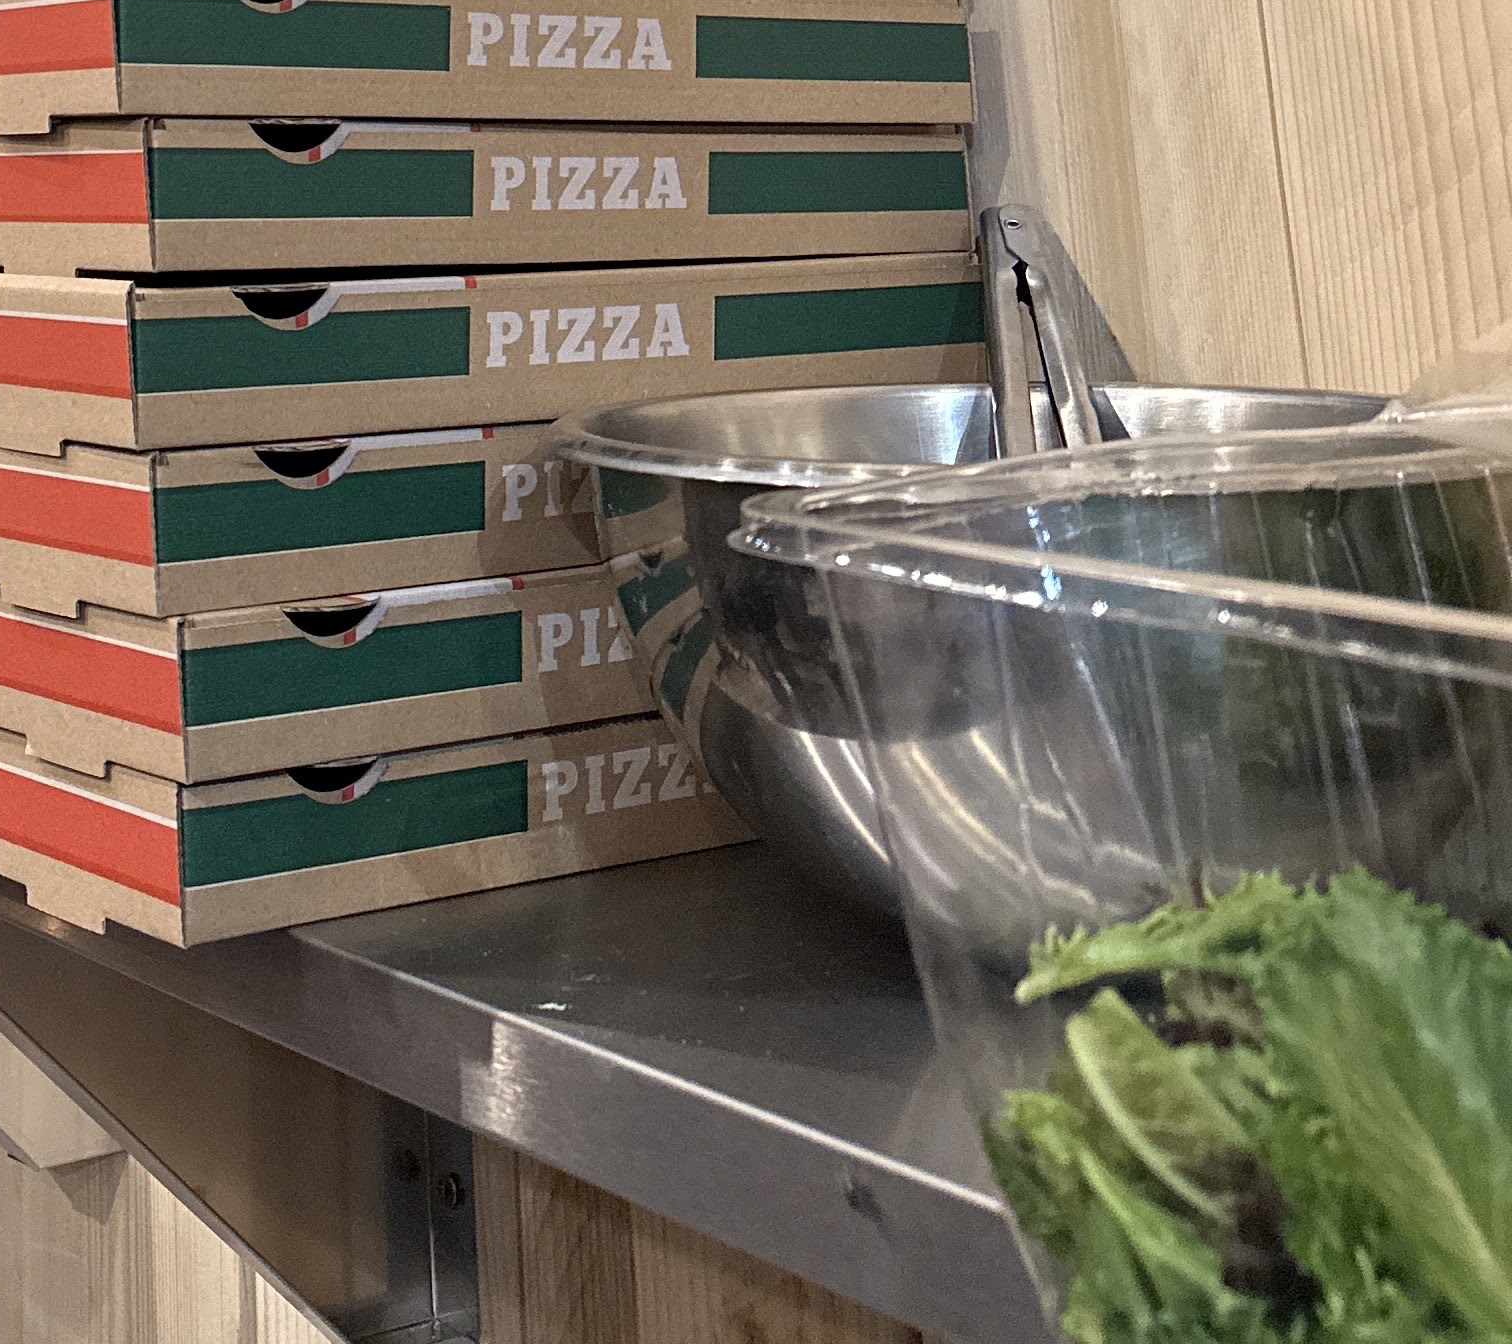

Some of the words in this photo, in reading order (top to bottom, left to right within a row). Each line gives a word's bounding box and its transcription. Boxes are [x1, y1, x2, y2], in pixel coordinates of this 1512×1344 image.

[466, 11, 672, 71] PIZZA
[490, 156, 687, 211] PIZZA
[485, 303, 690, 368] PIZZA
[541, 743, 717, 823] PIZZ
